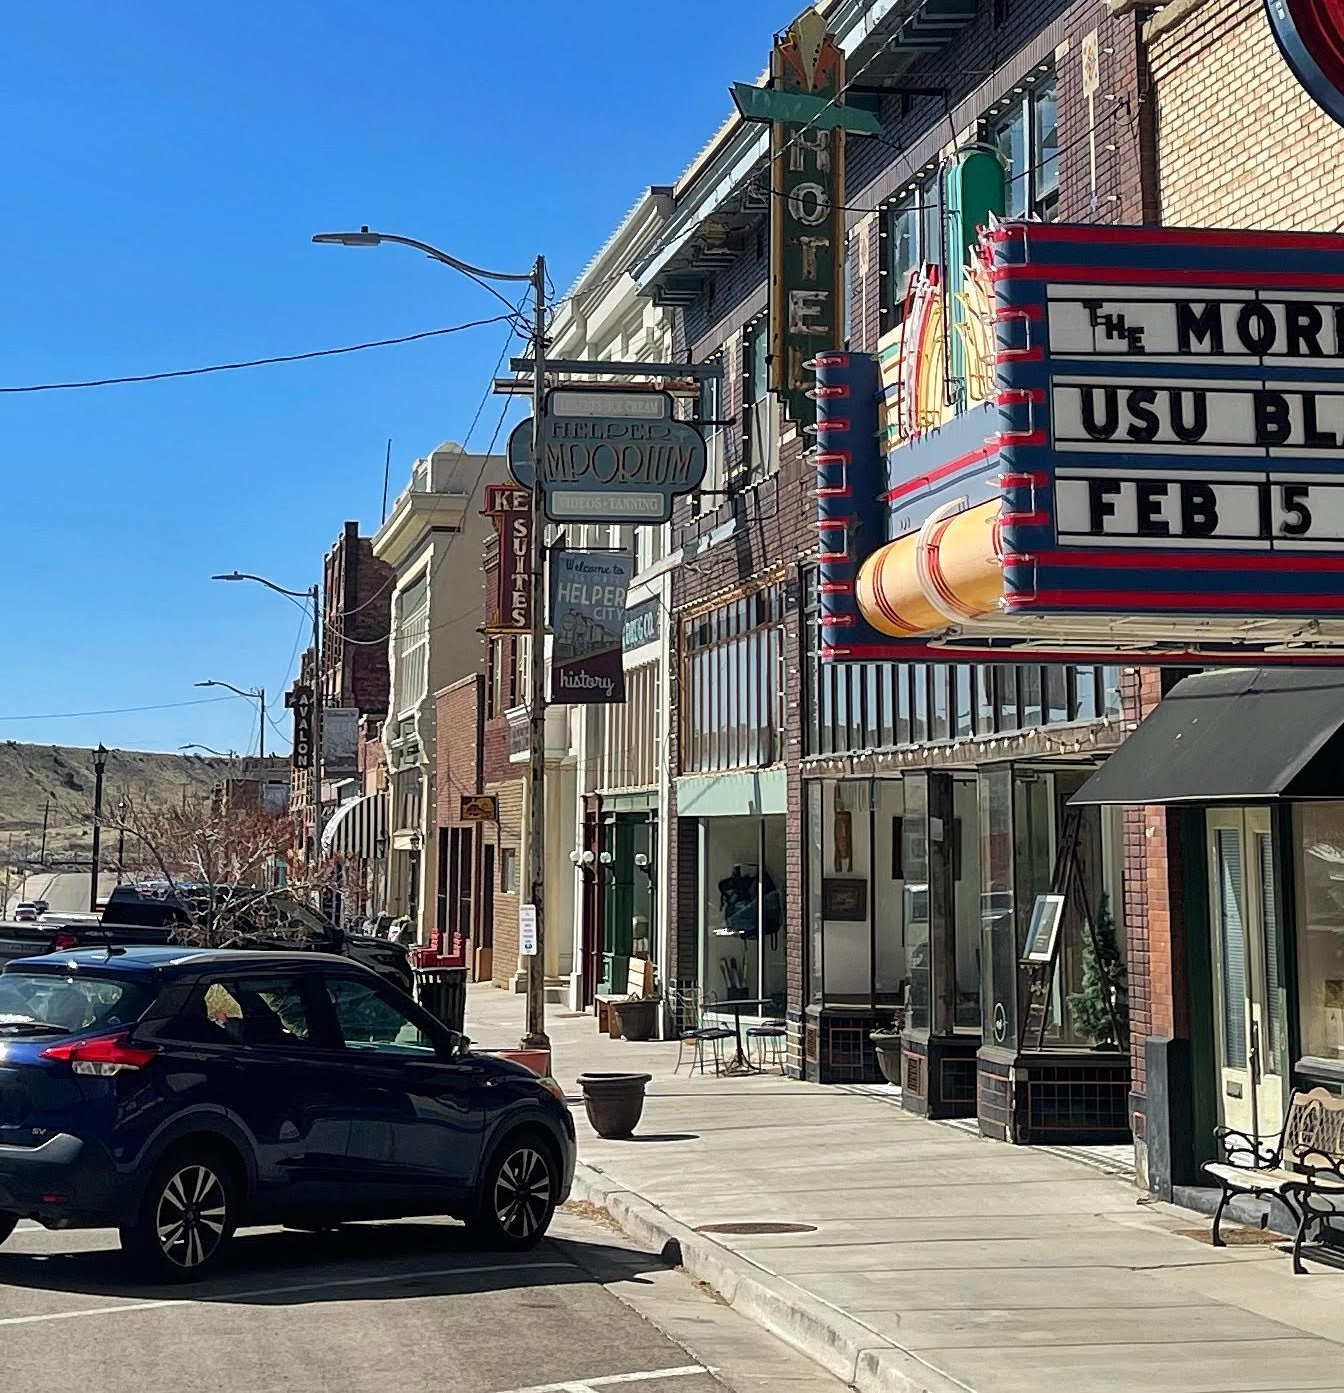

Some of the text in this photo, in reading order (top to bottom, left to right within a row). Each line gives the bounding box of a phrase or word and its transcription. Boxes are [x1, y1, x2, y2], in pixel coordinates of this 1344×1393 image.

[787, 127, 833, 392] HOTEL
[1083, 301, 1146, 354] THE
[551, 422, 672, 440] HELPER
[1080, 387, 1208, 442] USU
[531, 443, 696, 485] MPORIUM
[1088, 480, 1219, 537] FEB
[1259, 484, 1312, 537] 15
[511, 518, 529, 627] SUITES
[565, 558, 625, 575] Welcome to
[558, 581, 626, 608] HELPER
[593, 607, 625, 621] CITY
[559, 667, 615, 697] history
[298, 694, 309, 766] AVALON
[31, 1127, 47, 1135] SV
